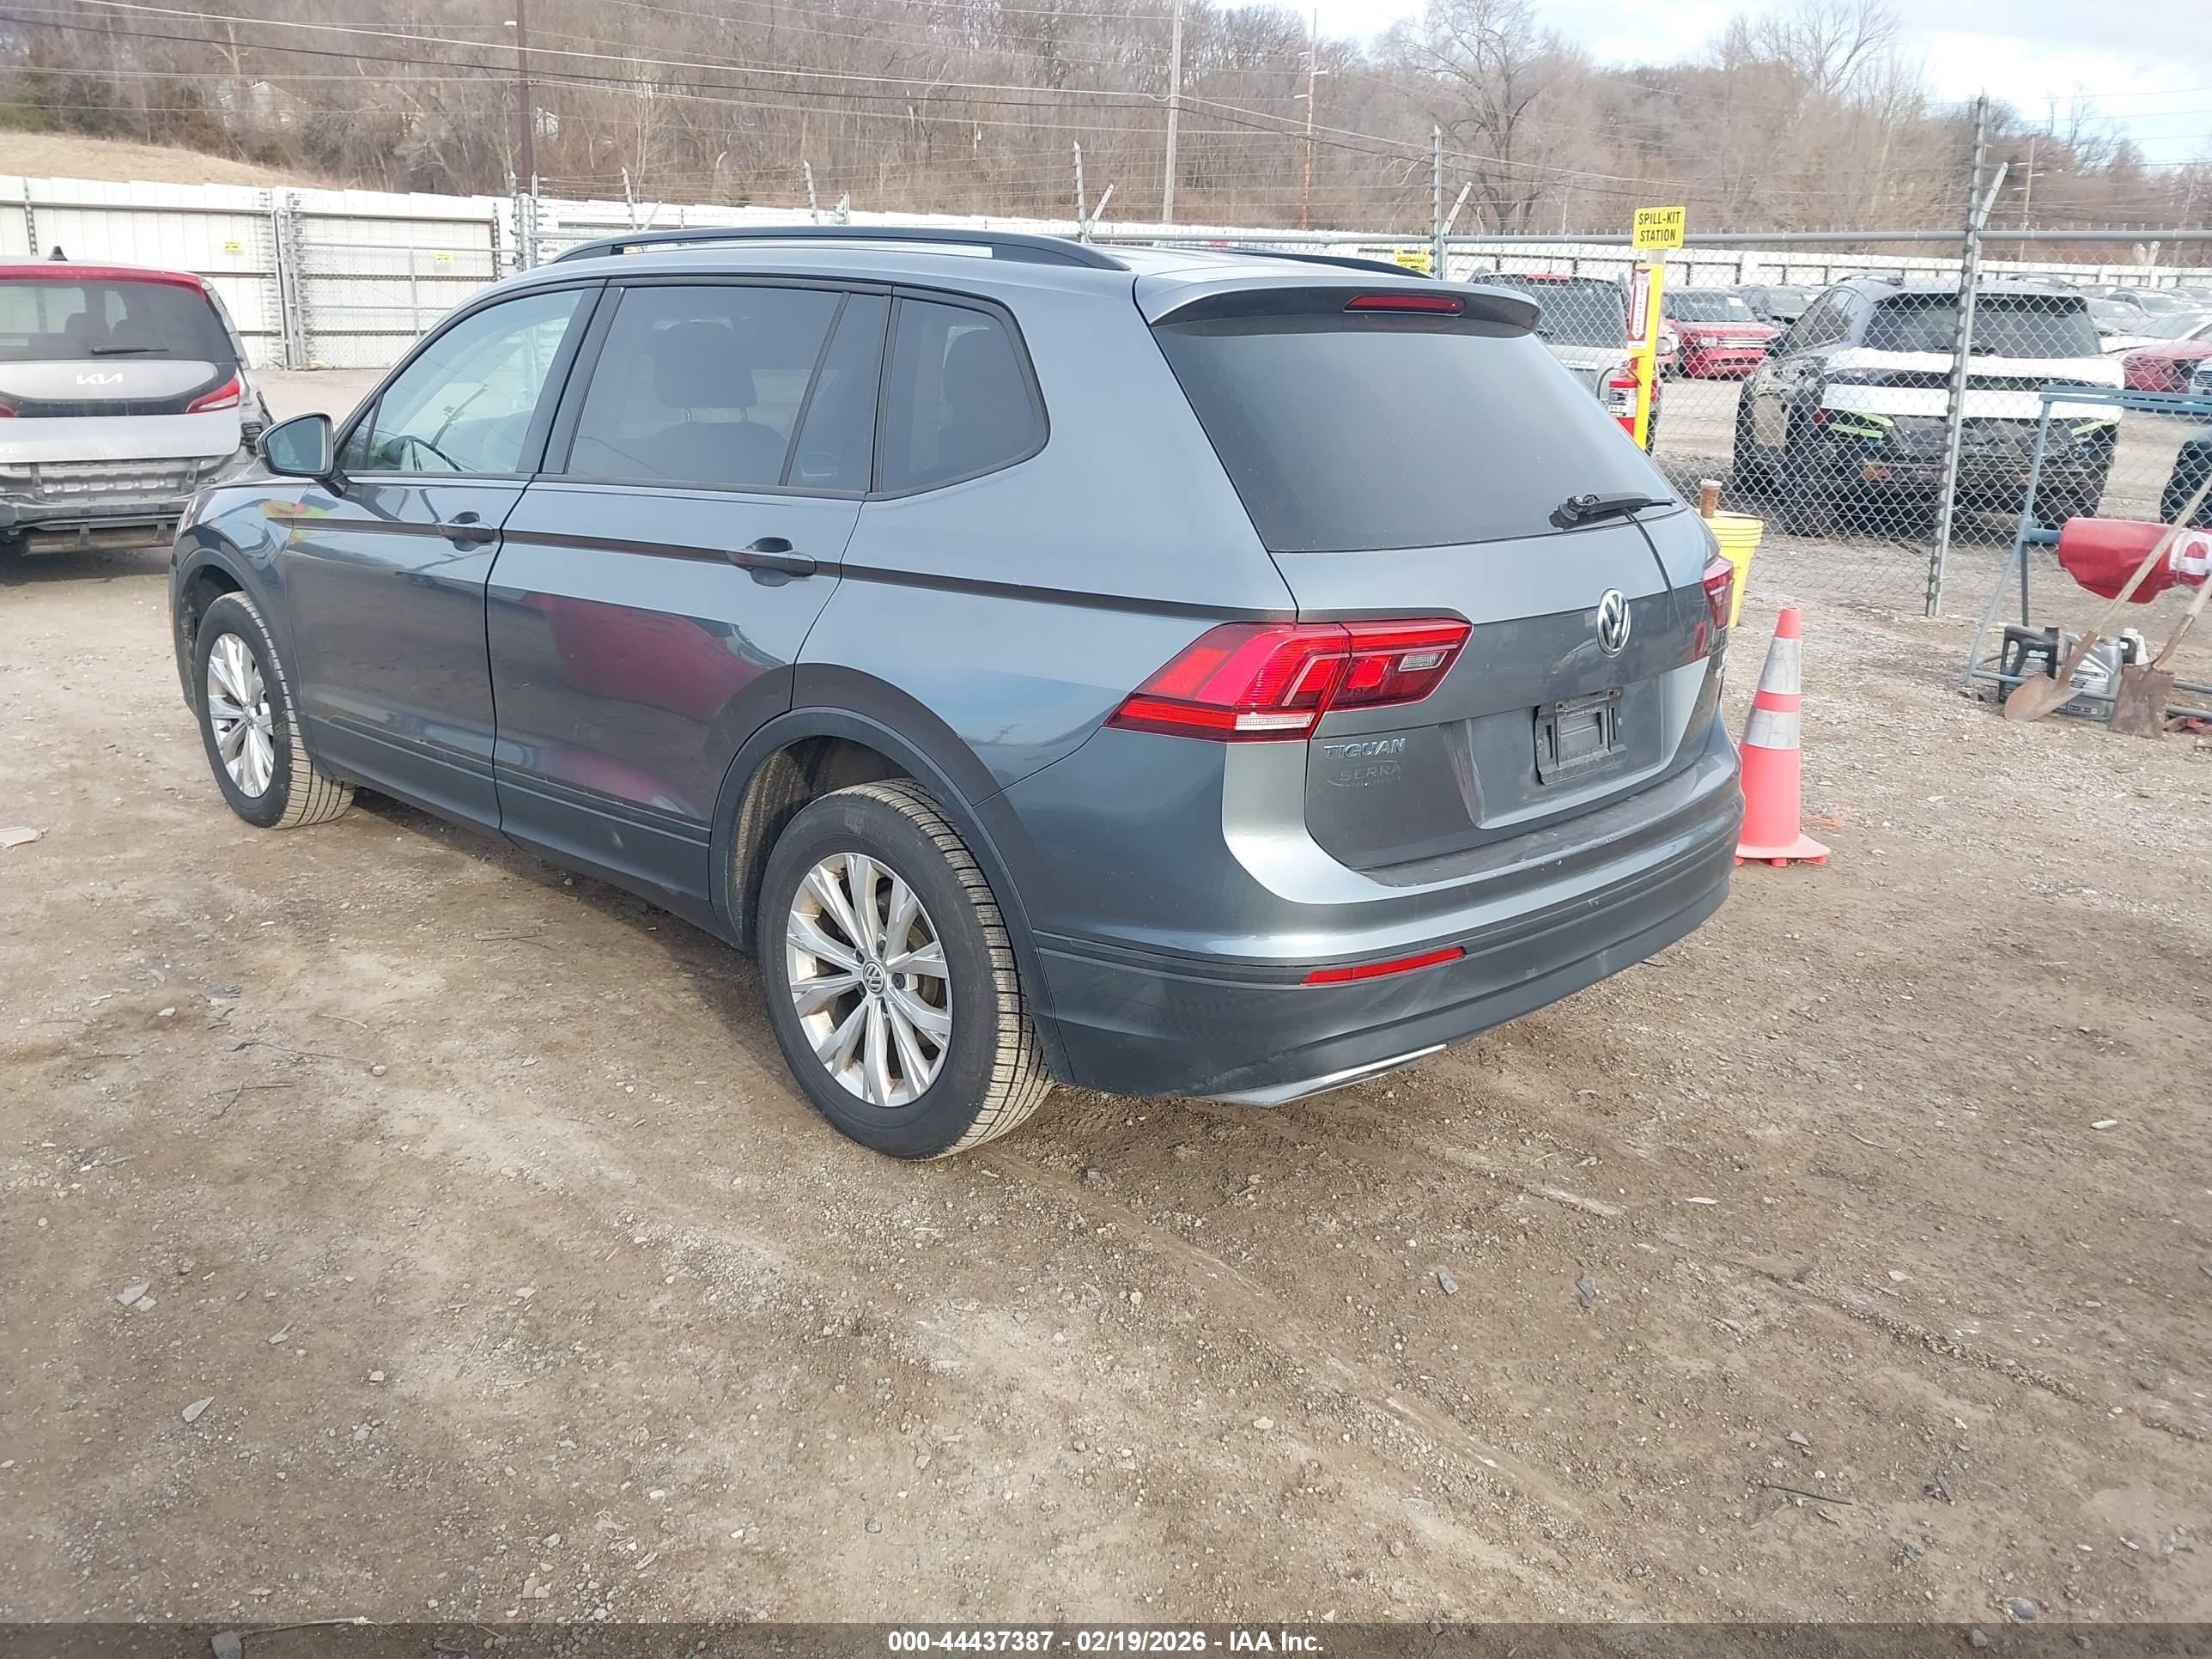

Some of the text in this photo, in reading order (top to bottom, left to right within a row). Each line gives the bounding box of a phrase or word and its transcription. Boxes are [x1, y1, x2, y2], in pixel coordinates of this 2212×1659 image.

[1638, 211, 1681, 225] SPILL-KIT
[1640, 228, 1676, 242] STATION
[76, 373, 124, 385] KIA
[1323, 738, 1407, 760] TIGUAN
[1340, 763, 1401, 781] SERRA
